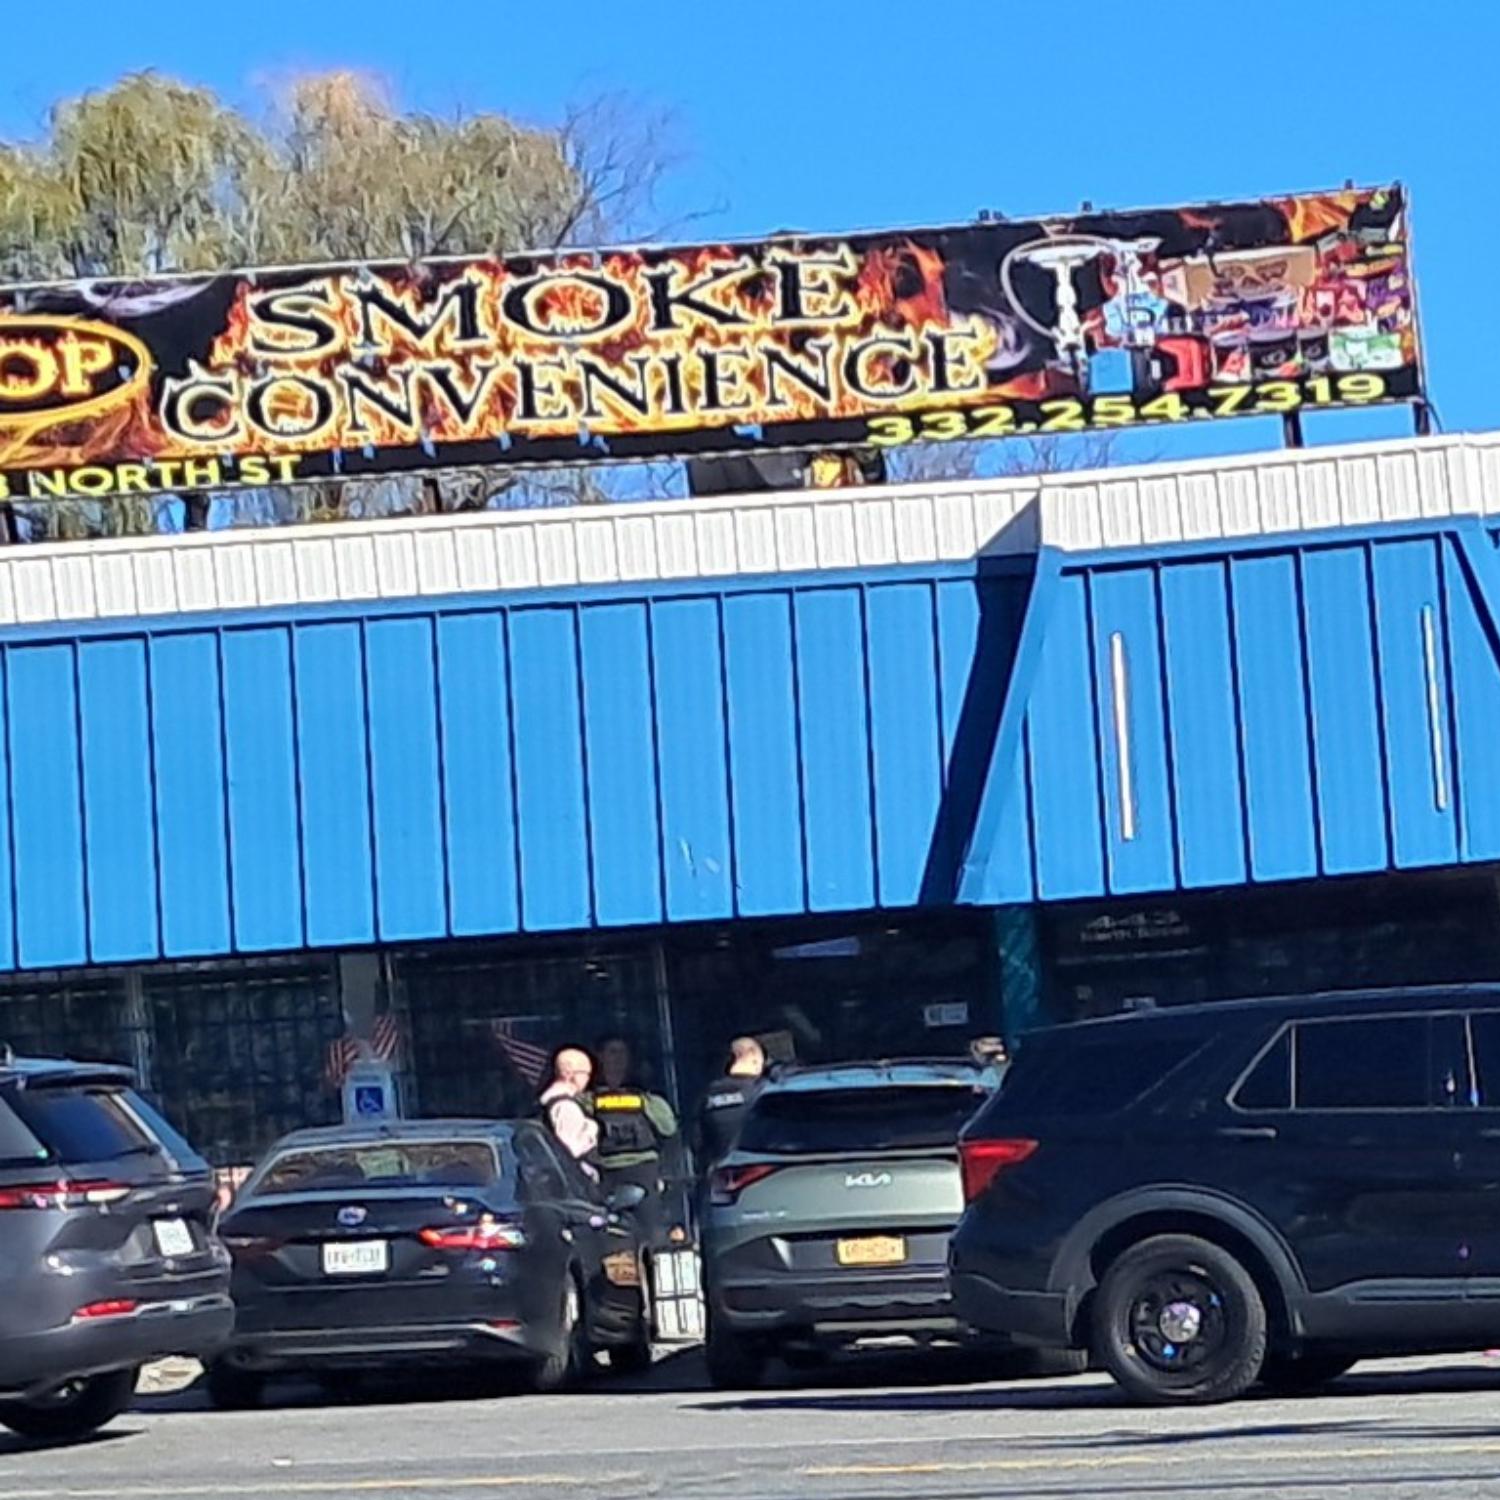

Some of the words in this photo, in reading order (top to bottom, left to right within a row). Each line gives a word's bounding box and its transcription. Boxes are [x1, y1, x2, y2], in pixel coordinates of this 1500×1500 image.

[249, 250, 856, 356] SMOKE
[163, 318, 990, 440] CONVENIENCE
[867, 374, 1386, 446] 332.254.7319
[29, 458, 221, 498] NORTH
[240, 454, 303, 486] ST
